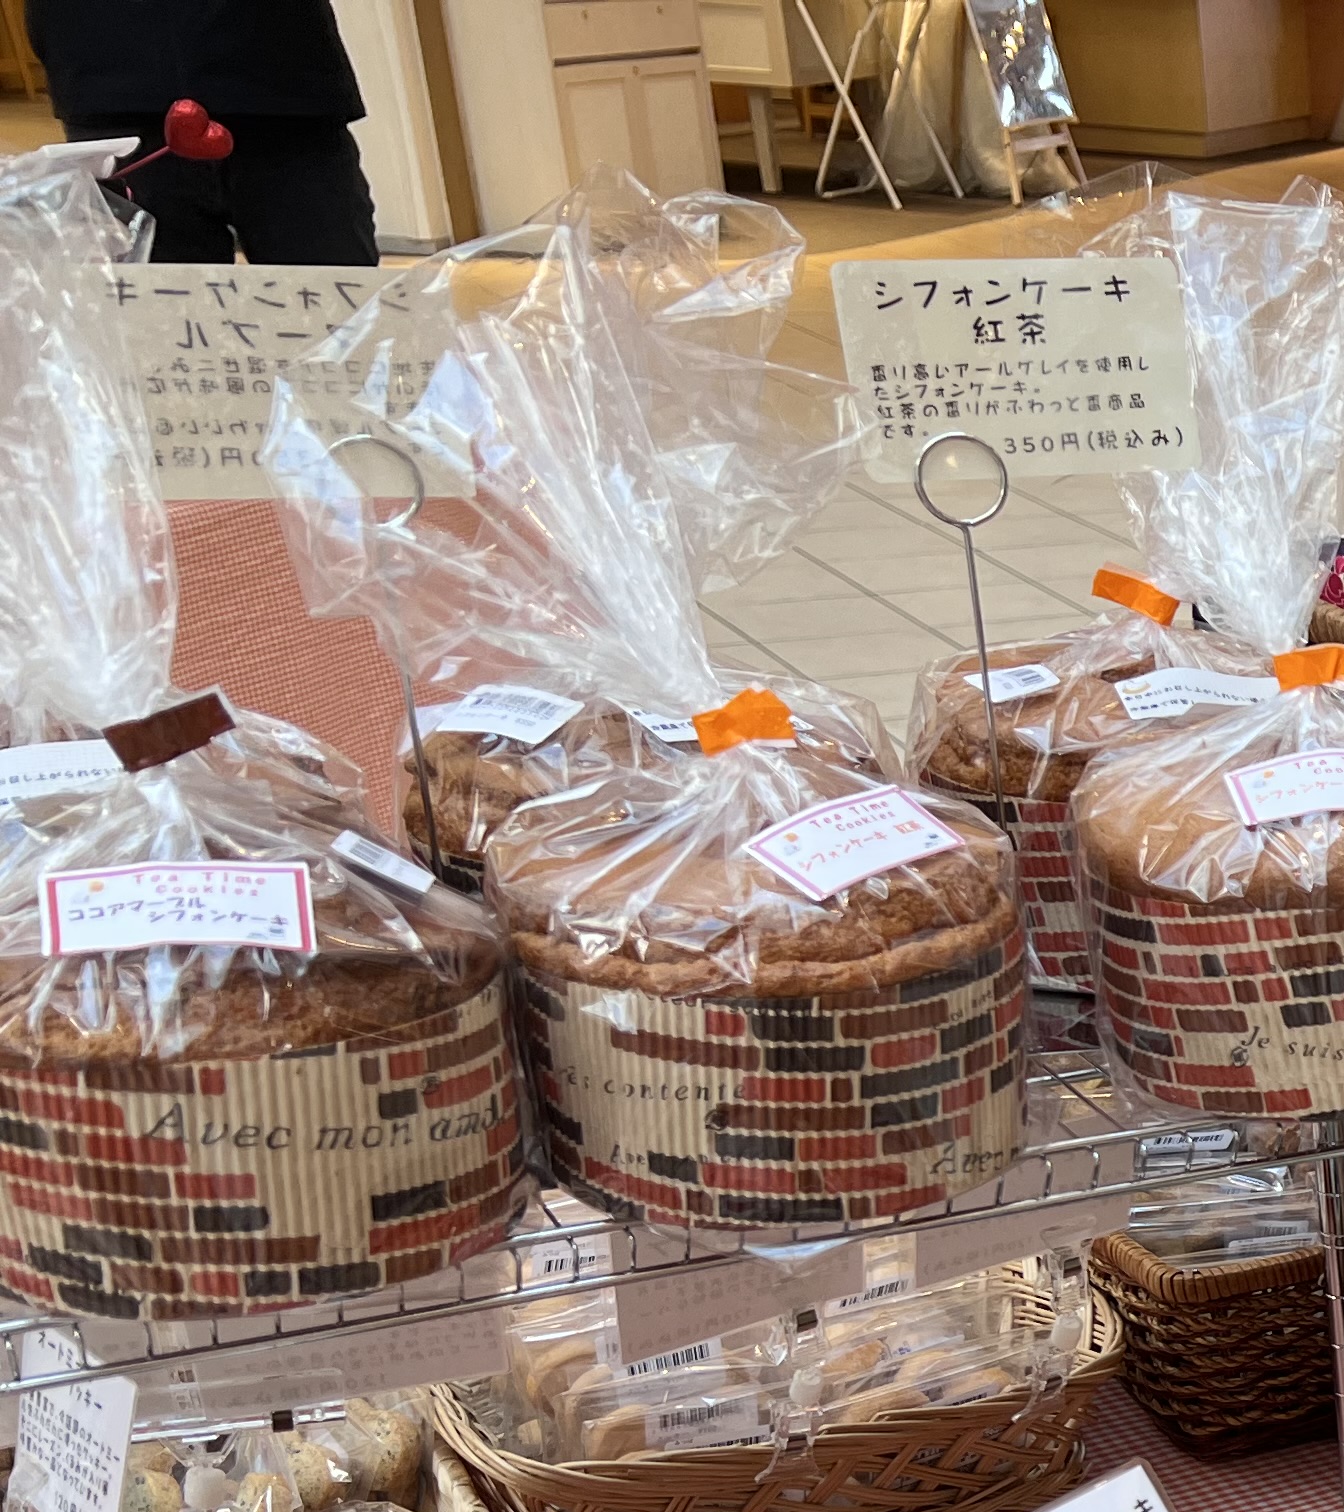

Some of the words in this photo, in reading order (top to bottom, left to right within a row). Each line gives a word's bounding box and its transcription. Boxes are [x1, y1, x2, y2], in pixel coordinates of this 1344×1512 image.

[873, 276, 1131, 310] シフォンケーキ
[971, 313, 1048, 345] 紅茶
[874, 380, 1042, 400] たシフォンケーキ。
[881, 423, 930, 440] です。
[1003, 426, 1185, 456] 350円(税込み)
[1287, 1041, 1344, 1062] suis
[602, 1076, 747, 1104] contente
[144, 1102, 293, 1152] Avec
[314, 1118, 415, 1152] mon
